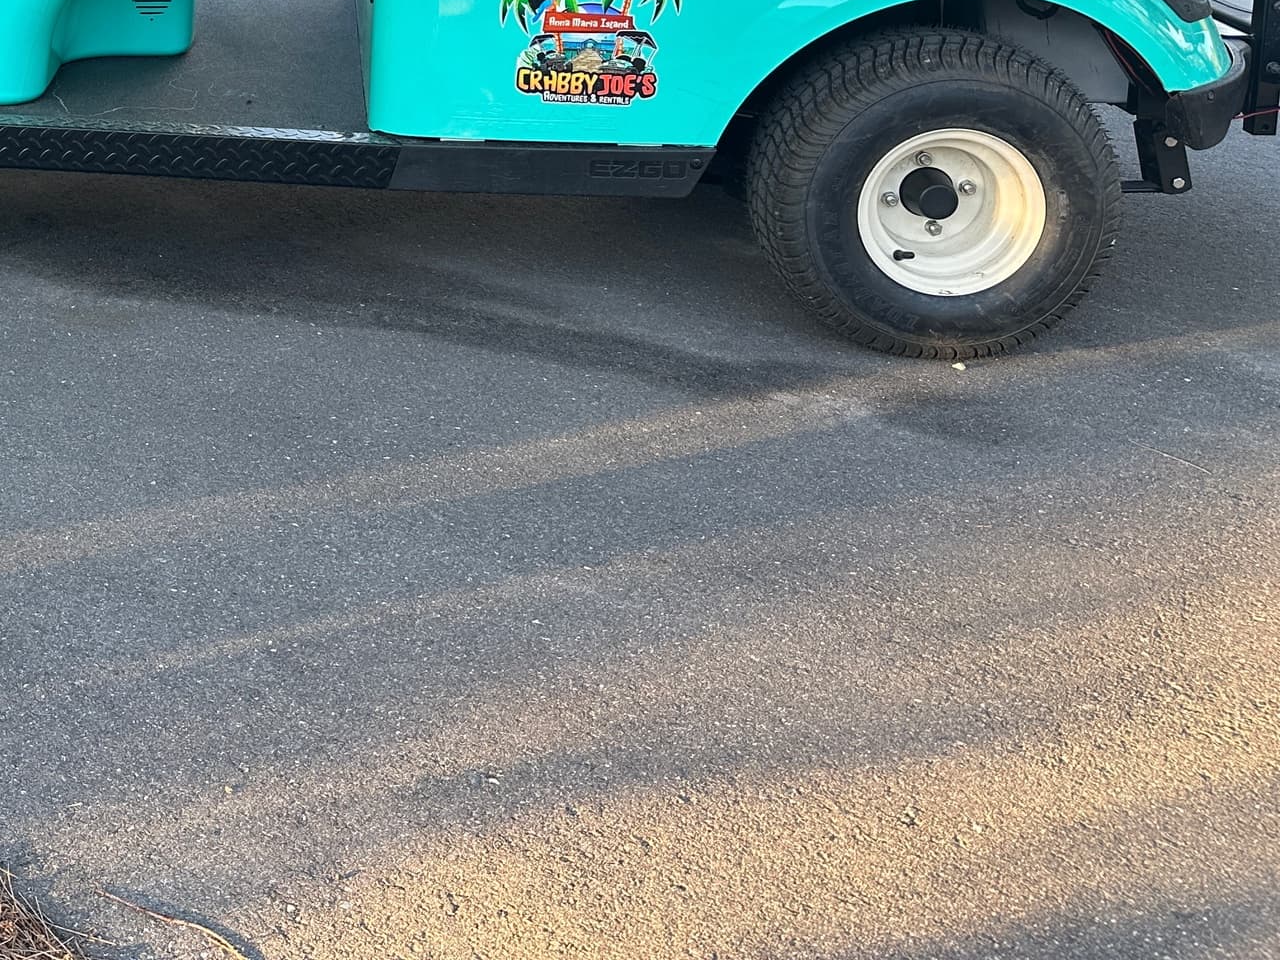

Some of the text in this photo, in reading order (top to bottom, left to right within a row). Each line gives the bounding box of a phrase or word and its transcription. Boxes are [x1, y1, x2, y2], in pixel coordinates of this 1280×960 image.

[549, 16, 629, 29] Anna Maria Island
[518, 69, 655, 96] CRABBY JOE'S
[590, 94, 597, 102] &
